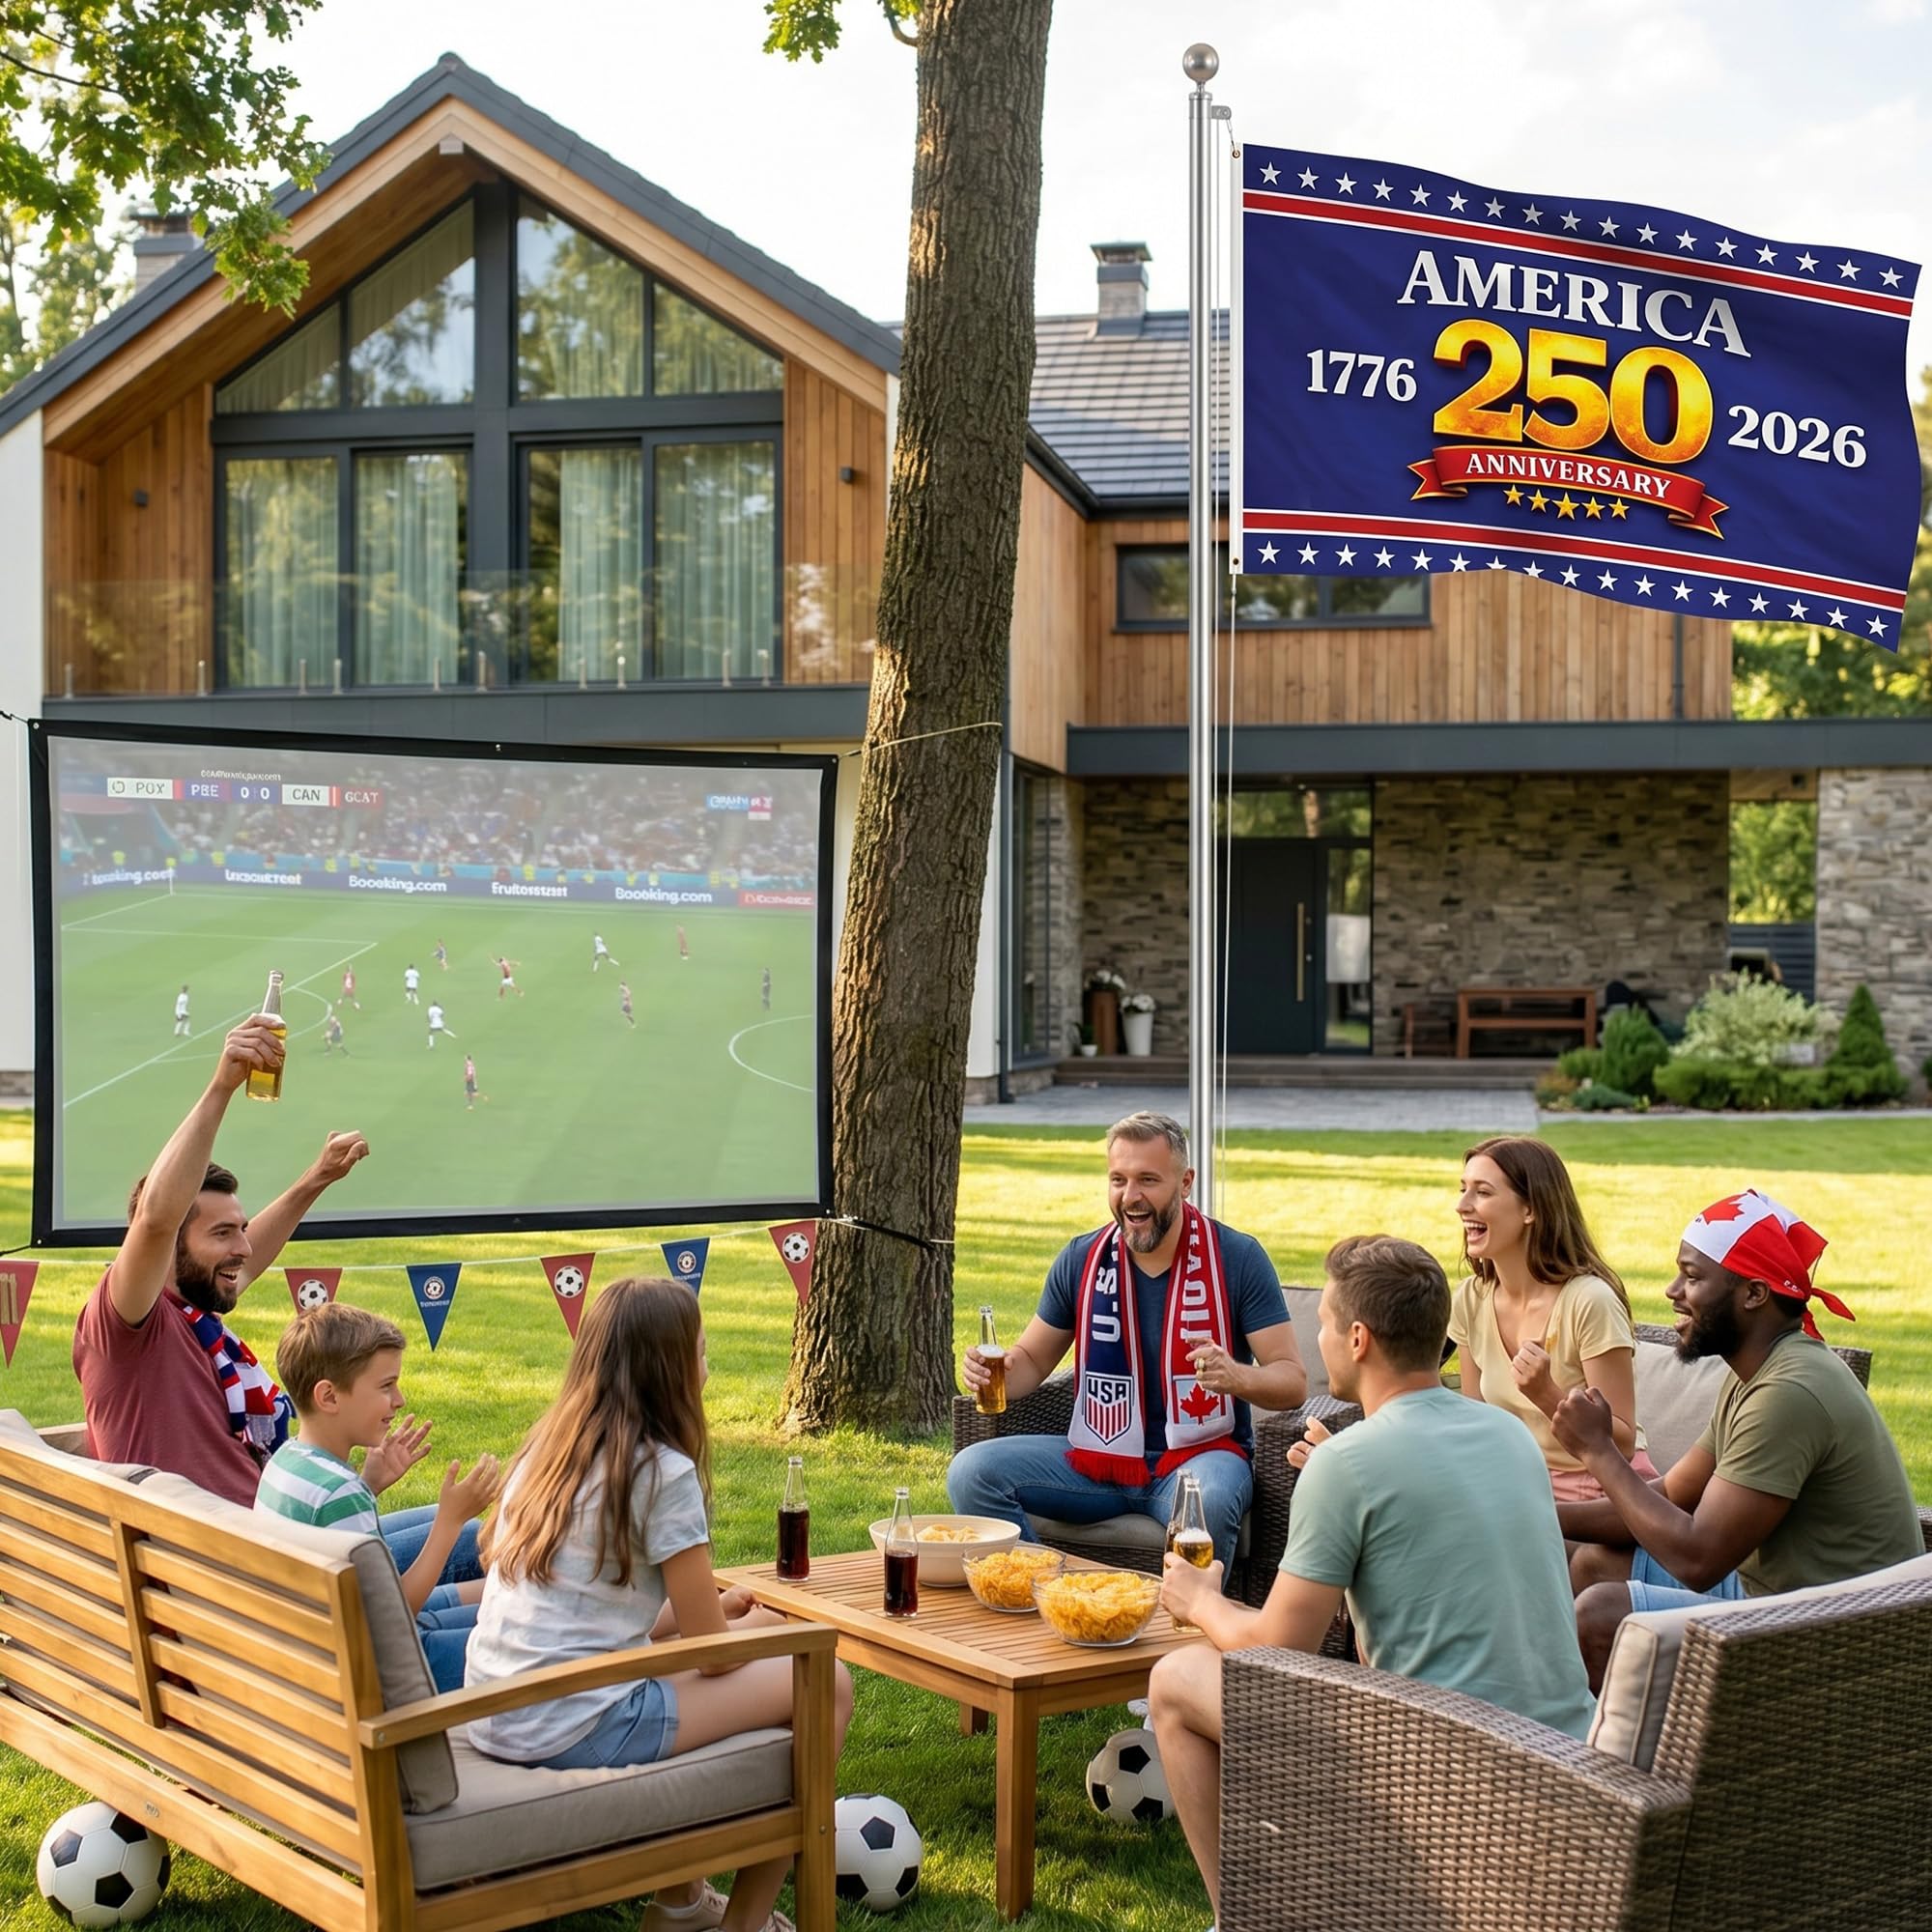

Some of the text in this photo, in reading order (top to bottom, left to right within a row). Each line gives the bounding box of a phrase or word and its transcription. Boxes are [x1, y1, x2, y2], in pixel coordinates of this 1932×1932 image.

[1397, 249, 1751, 358] AMERICA
[1306, 348, 1418, 403] 1776
[1432, 319, 1715, 464] 250
[1726, 404, 1868, 469] 2026
[1464, 451, 1672, 499] ANNIVERSARY
[292, 788, 321, 801] CAN
[1088, 1378, 1127, 1405] USA
